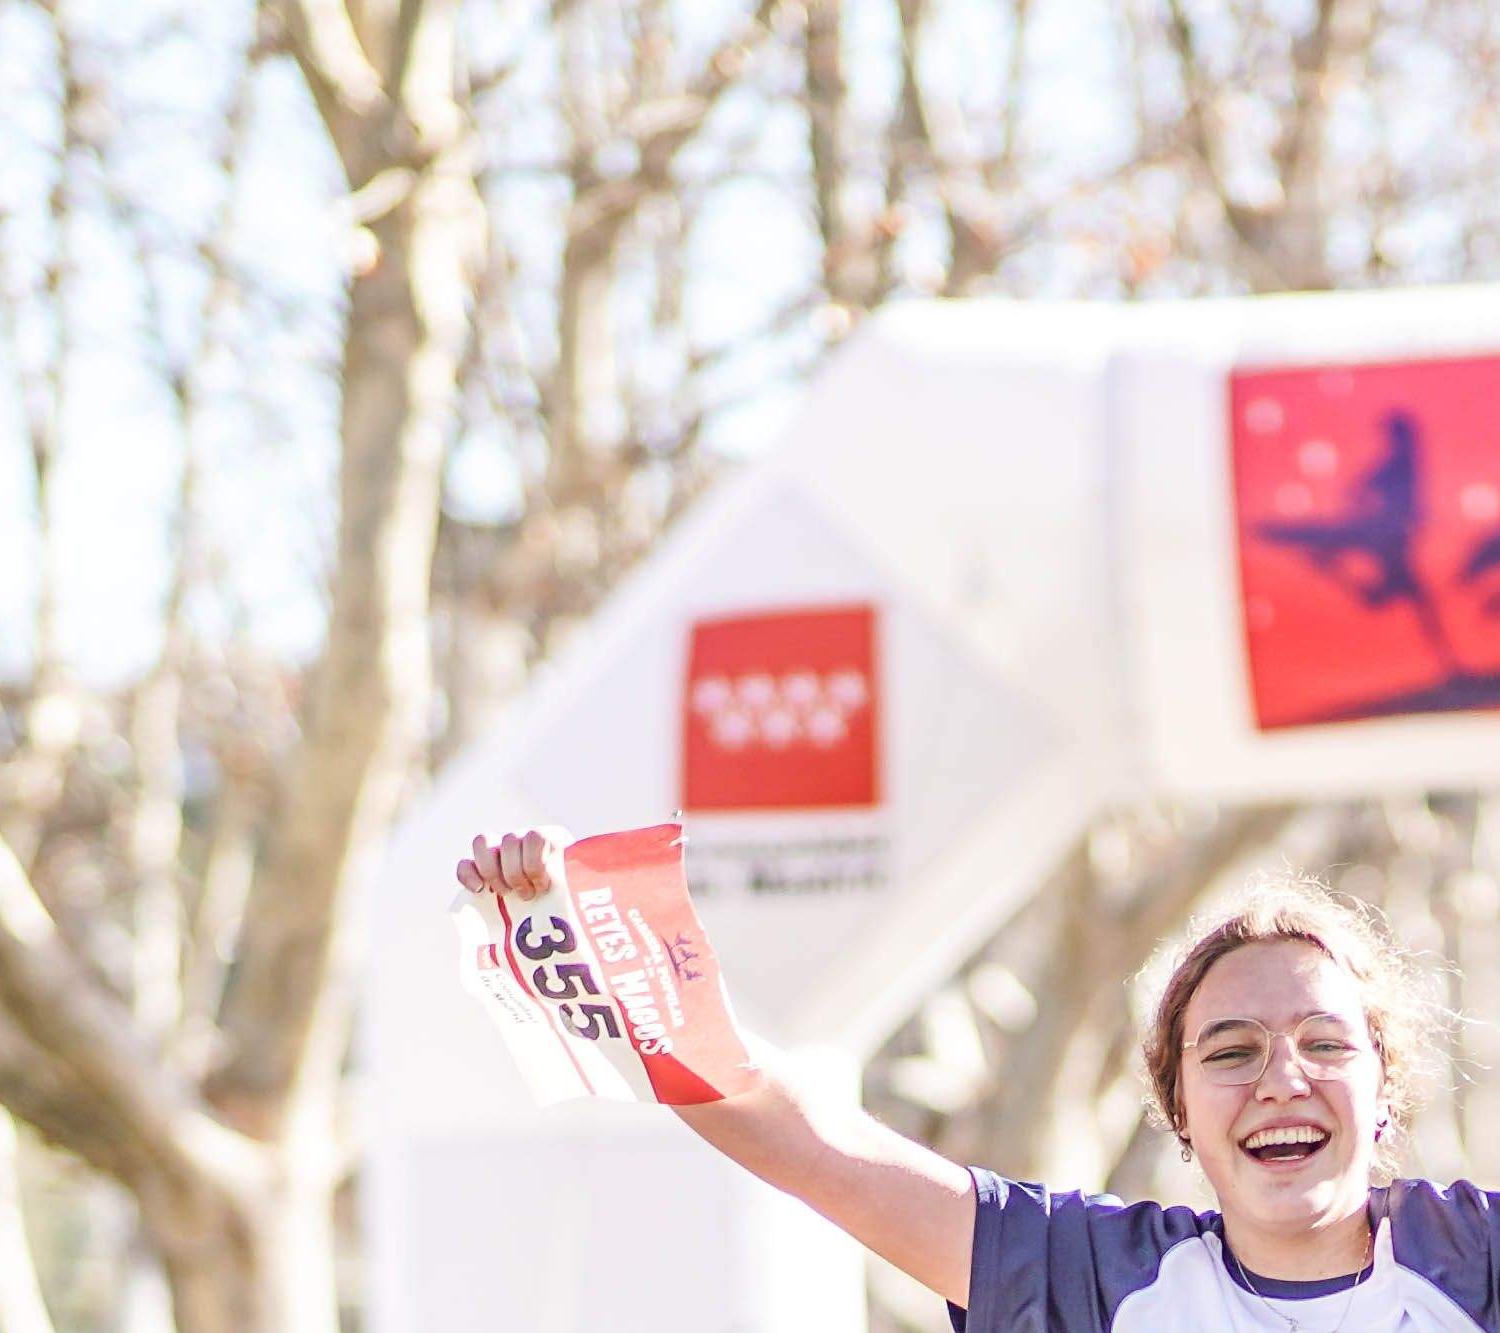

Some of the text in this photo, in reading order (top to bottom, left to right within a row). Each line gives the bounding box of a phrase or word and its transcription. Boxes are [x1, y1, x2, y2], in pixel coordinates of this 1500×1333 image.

[516, 916, 621, 1040] 355
[578, 886, 673, 1055] REYES MAGOS
